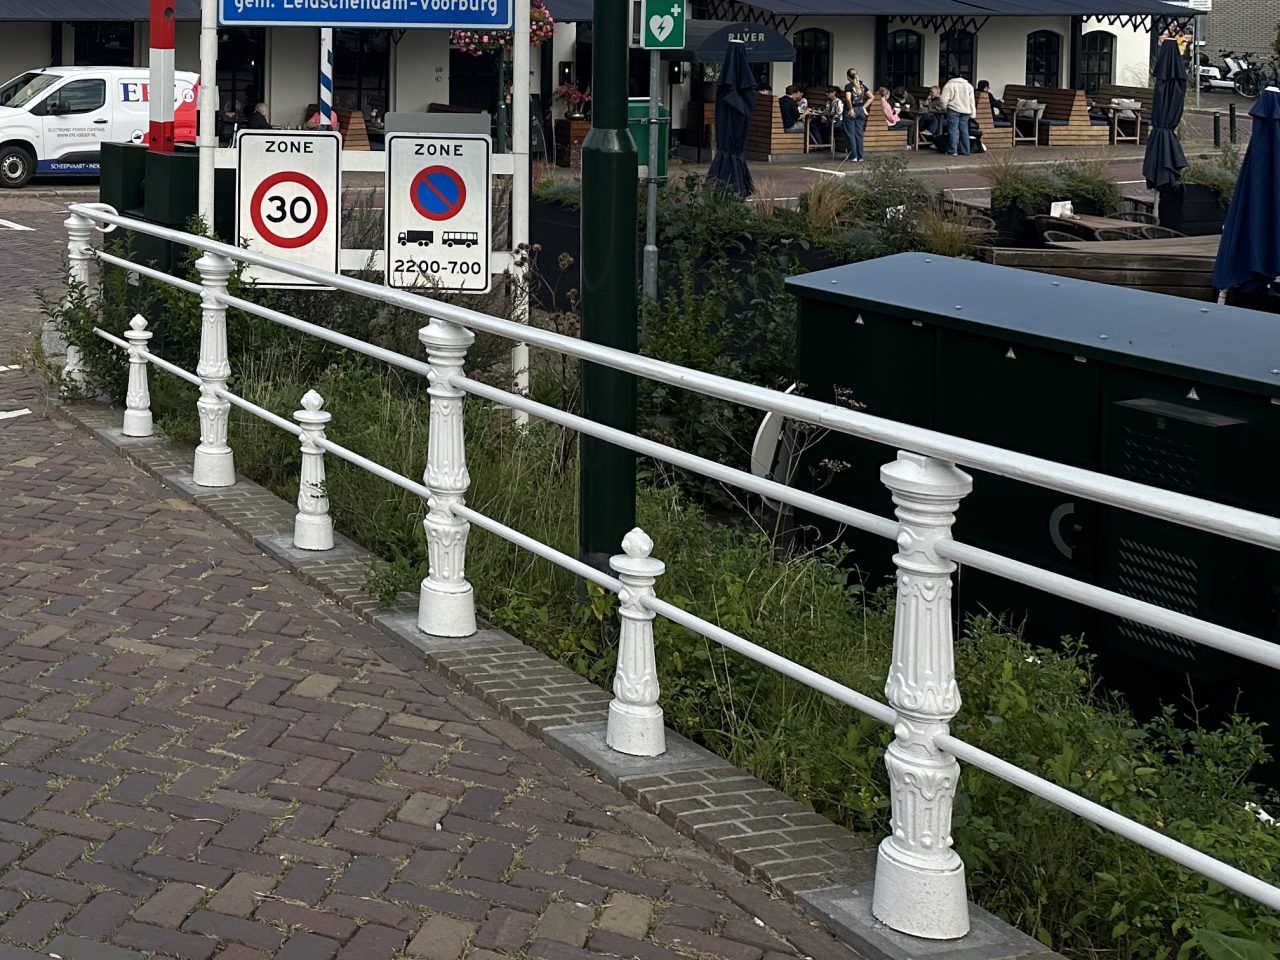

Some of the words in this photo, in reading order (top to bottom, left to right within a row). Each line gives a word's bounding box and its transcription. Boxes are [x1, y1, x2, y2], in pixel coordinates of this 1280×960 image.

[728, 32, 765, 42] RIVER
[265, 140, 314, 154] ZONE
[414, 143, 463, 156] ZONE
[265, 195, 312, 224] 30
